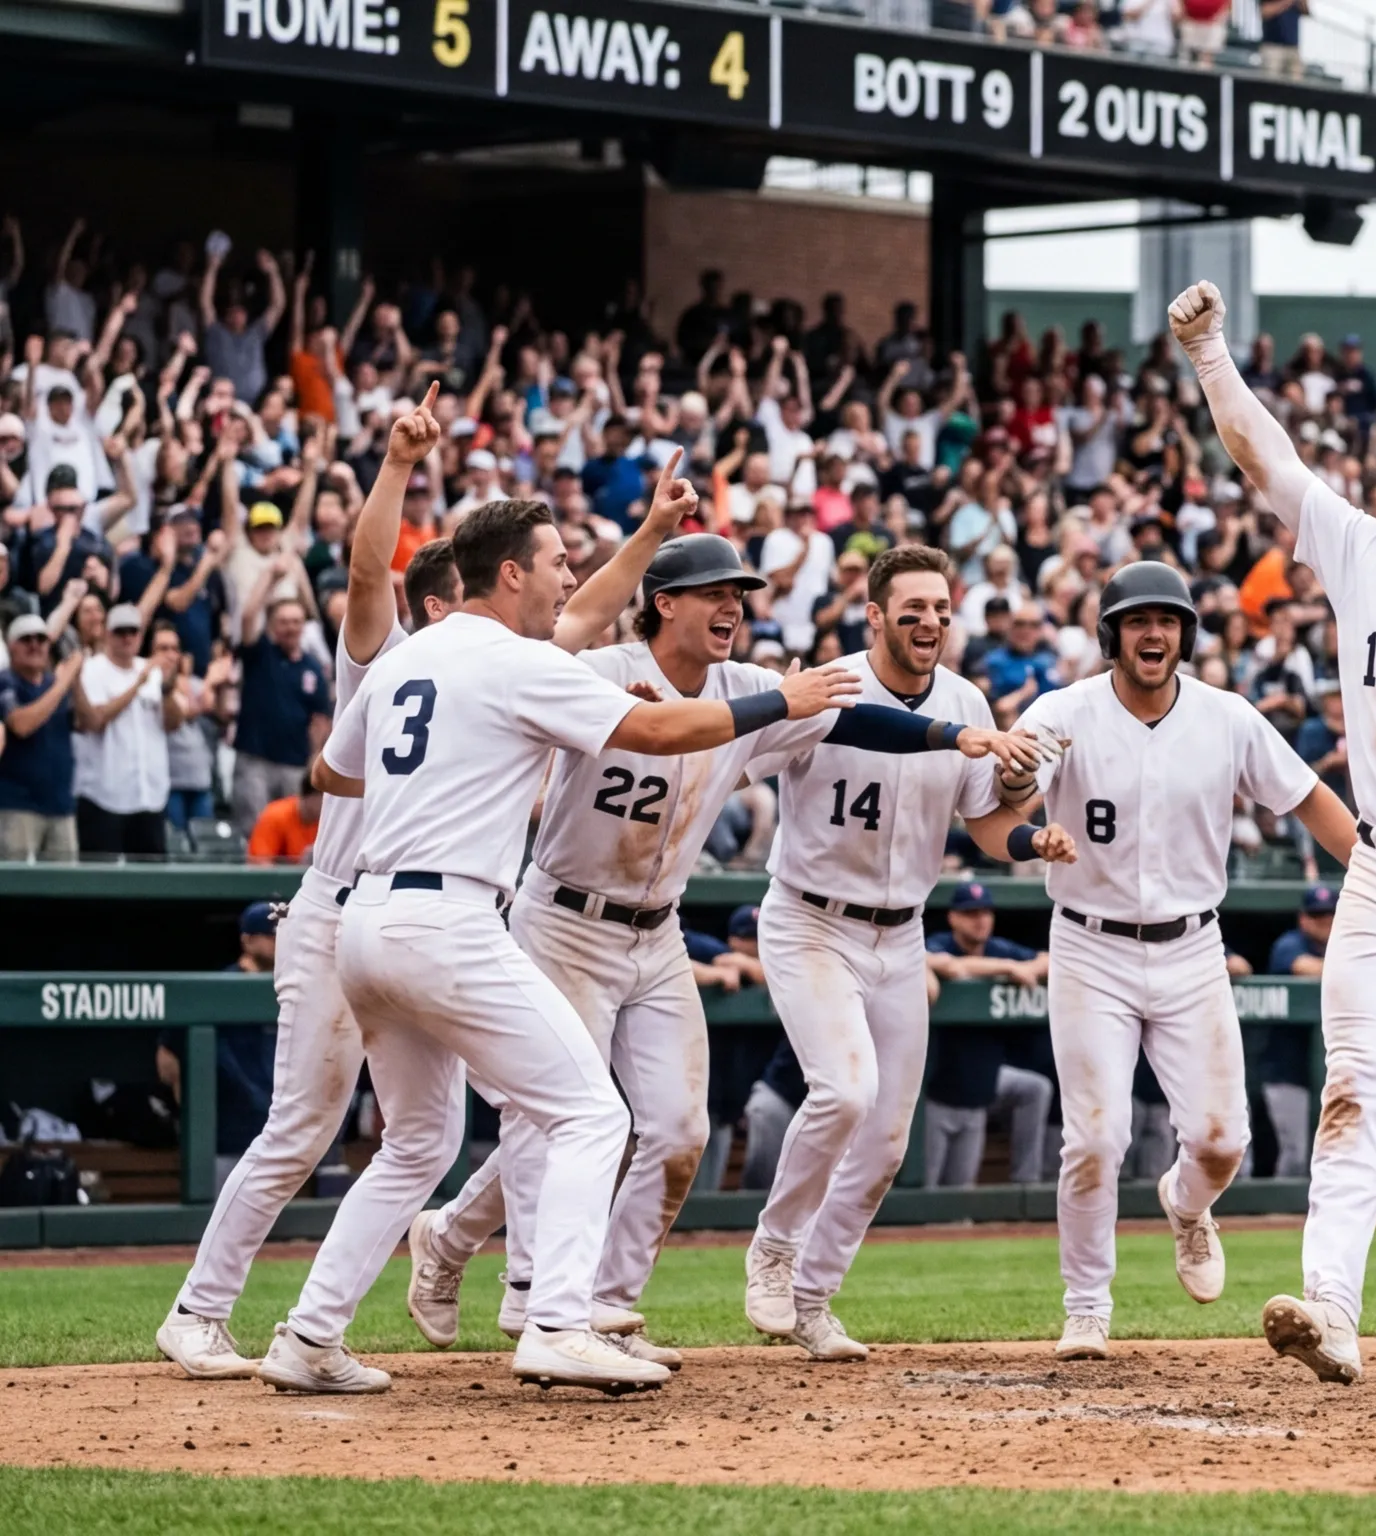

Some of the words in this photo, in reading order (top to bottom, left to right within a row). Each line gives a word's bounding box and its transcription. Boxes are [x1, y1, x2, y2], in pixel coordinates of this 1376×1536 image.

[224, 0, 400, 55] HOME:
[433, 0, 471, 67] 5
[520, 12, 680, 89] AWAY:
[710, 32, 749, 99] 4
[854, 53, 974, 122] BOTT
[981, 71, 1013, 128] 9
[1058, 80, 1088, 137] 2
[1095, 86, 1208, 151] OUTS
[1249, 102, 1375, 172] FINAL
[381, 679, 438, 775] 3
[593, 766, 669, 825] 22
[829, 778, 881, 831] 14
[1085, 798, 1116, 844] 8
[41, 983, 165, 1019] STADIUM
[989, 984, 1048, 1018] STAD
